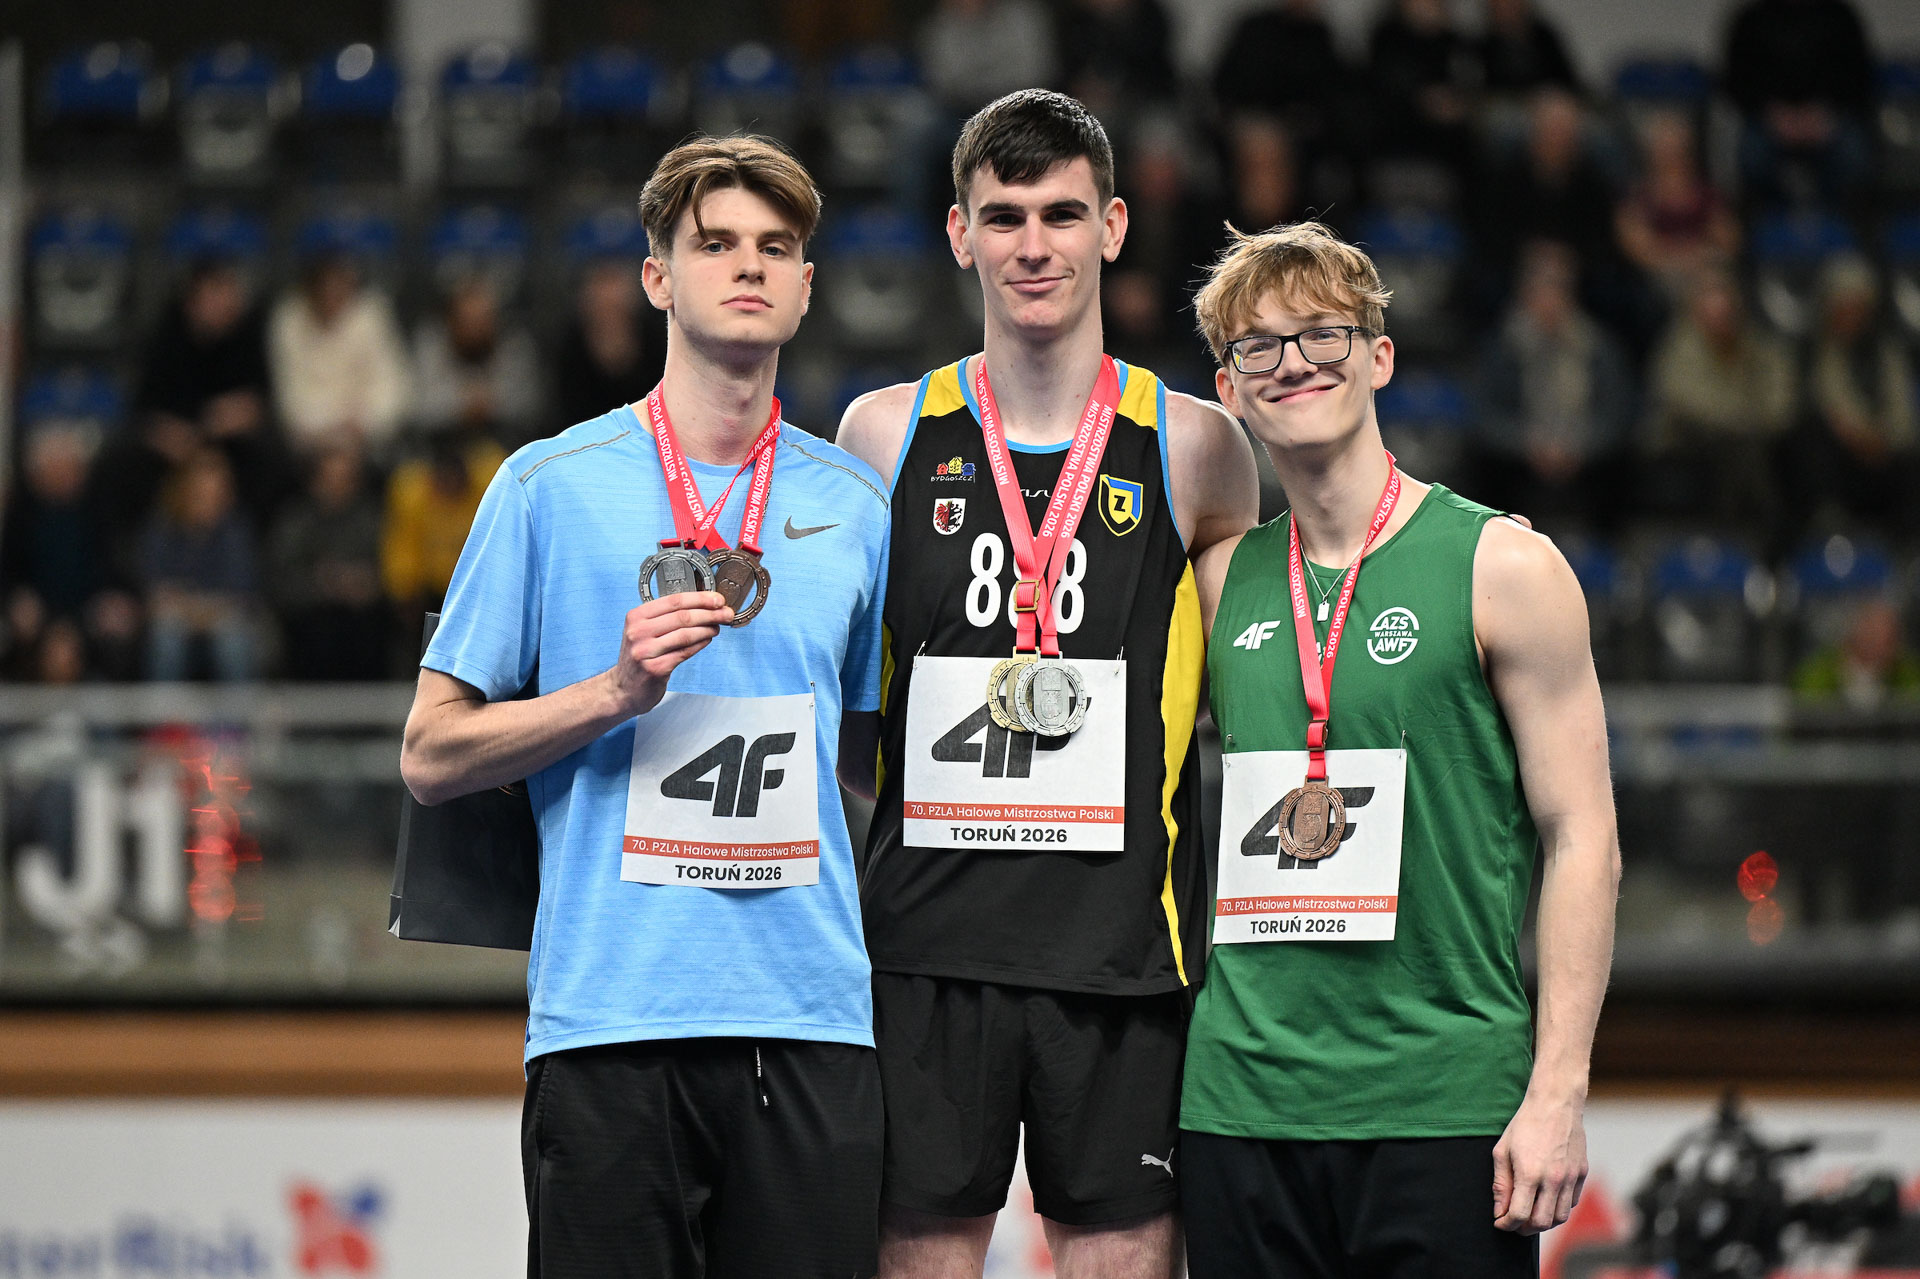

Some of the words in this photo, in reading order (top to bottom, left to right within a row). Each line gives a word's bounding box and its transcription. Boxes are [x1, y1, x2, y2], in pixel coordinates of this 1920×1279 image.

[977, 376, 991, 413] POLSKI
[1067, 399, 1100, 470] MISTRZOSTWA
[1082, 404, 1113, 473] MISTRZOSTWA
[656, 420, 678, 482] MISTRZOSTWA
[984, 412, 1010, 486] MISTRZOSTWA
[752, 445, 773, 507] MISTRZOSTWA
[1052, 471, 1075, 511] POLSKI
[1069, 473, 1091, 512] POLSKI
[1113, 494, 1126, 513] Z
[745, 506, 761, 534] POLSKI
[1042, 511, 1060, 537] 2026
[1374, 492, 1395, 529] POLSKI
[1061, 512, 1077, 538] 2026
[1290, 547, 1306, 619] MISTRZOSTWA
[1333, 590, 1350, 629] POLSKI
[1380, 616, 1409, 630] AZS
[1233, 621, 1281, 650] 4F
[1326, 631, 1339, 659] 2026
[1374, 638, 1409, 652] AWF
[660, 732, 796, 818] 4F
[911, 804, 926, 816] 70.
[928, 805, 954, 817] PZLA
[956, 806, 1001, 818] Halowe
[1004, 807, 1077, 819] Mistrzostwa
[1079, 808, 1115, 820] Polski
[632, 839, 649, 851] 70.
[652, 841, 680, 854] PZLA
[683, 844, 729, 857] Halowe
[730, 845, 789, 857] Mistrzostwa
[790, 843, 814, 856] Polski
[950, 825, 1016, 842] TORUŃ
[1020, 828, 1068, 843] 2026
[675, 864, 741, 881] TORUŃ
[744, 866, 782, 881] 2026
[1222, 901, 1234, 912] 70.
[1235, 900, 1254, 911] PZLA
[1256, 899, 1291, 910] Halowe
[1292, 898, 1356, 909] Mistrzostwa
[1358, 898, 1388, 909] Polski
[1250, 916, 1301, 935] TORUŃ
[1305, 919, 1347, 933] 2026
